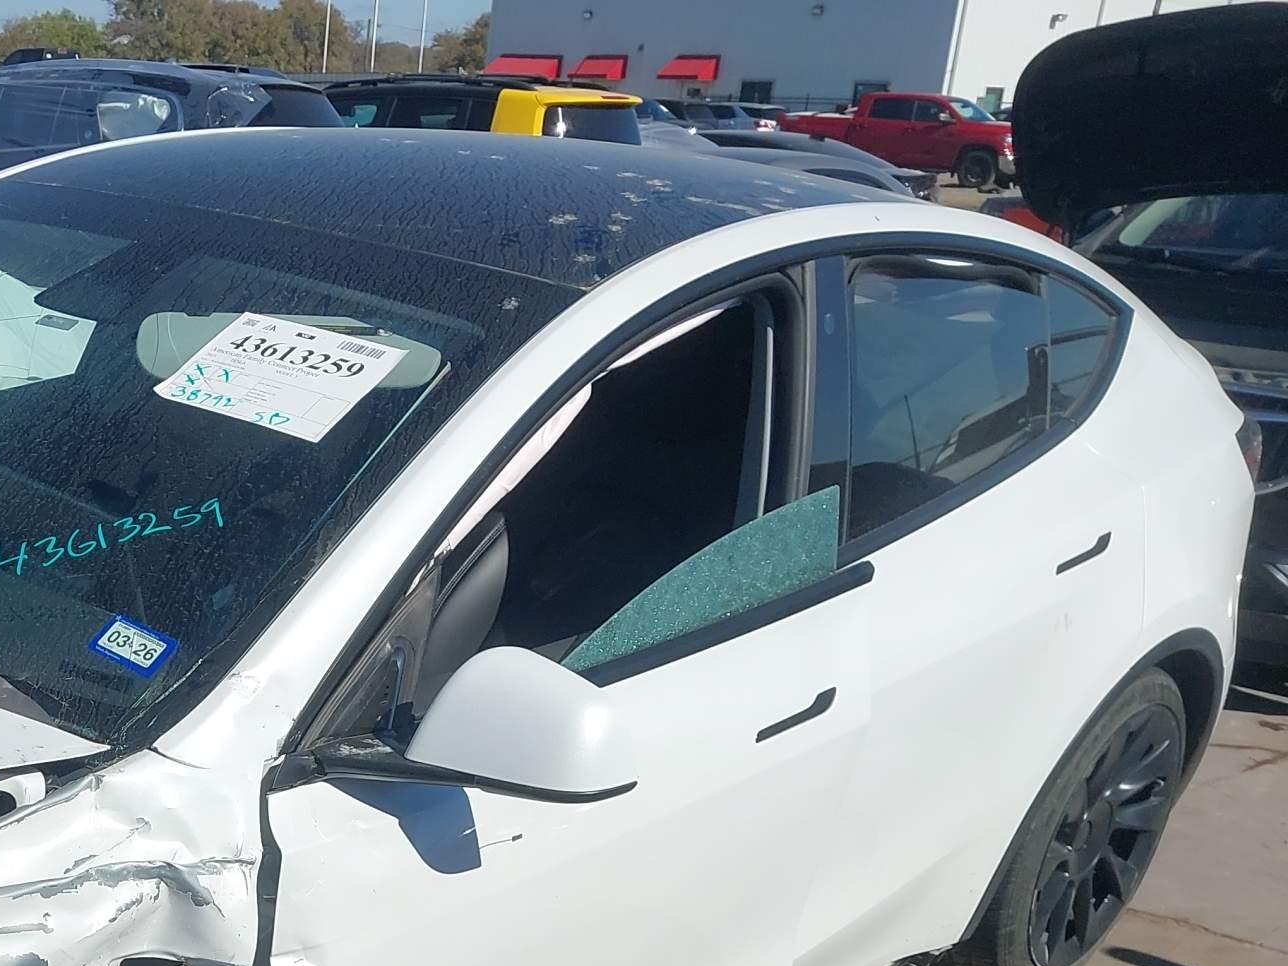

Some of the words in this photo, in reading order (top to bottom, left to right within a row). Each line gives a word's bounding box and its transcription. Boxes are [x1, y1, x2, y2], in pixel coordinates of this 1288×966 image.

[213, 346, 244, 359] American
[242, 352, 268, 365] Family
[267, 358, 297, 373] Connect
[295, 366, 321, 378] Proper
[229, 335, 366, 378] 43613259
[107, 630, 130, 648] 03
[133, 643, 158, 661] 26
